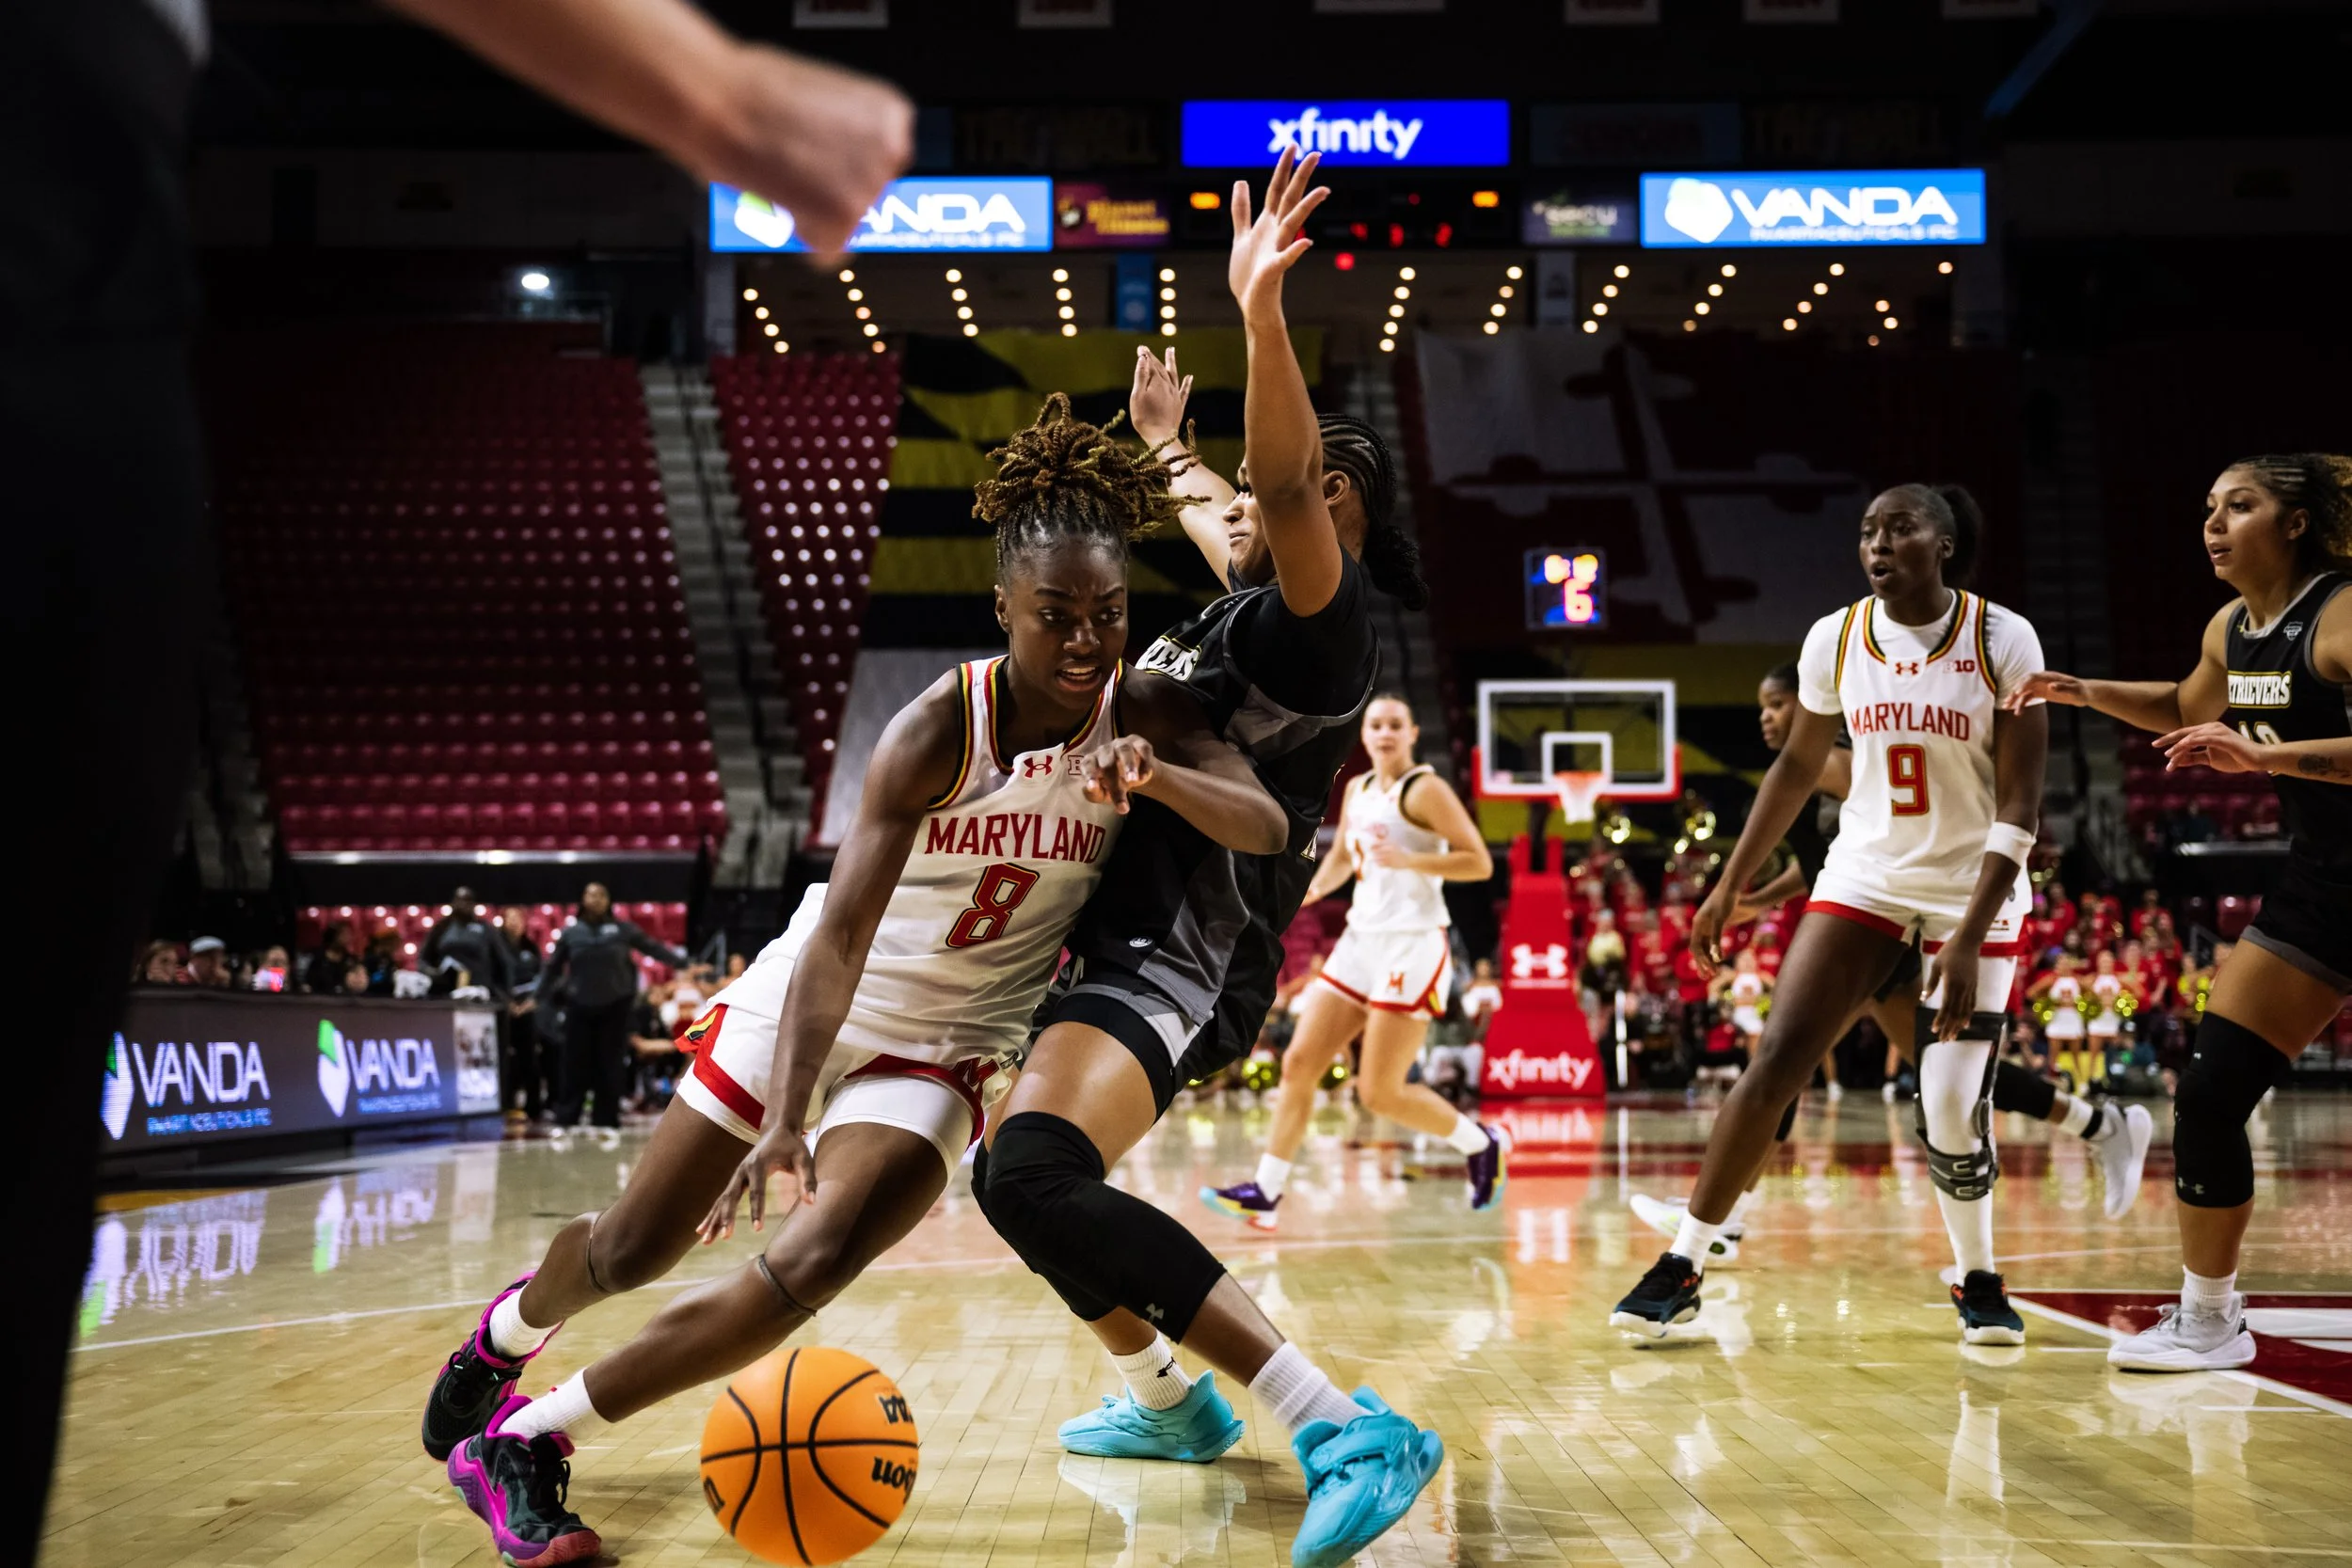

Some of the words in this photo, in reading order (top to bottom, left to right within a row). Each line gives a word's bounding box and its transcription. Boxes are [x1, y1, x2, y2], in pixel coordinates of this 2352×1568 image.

[1267, 106, 1422, 160] xfinity
[1730, 186, 1959, 227] VANDA
[1851, 702, 1970, 741] MARYLAND
[1886, 743, 1930, 816] 9
[924, 813, 1106, 864] MARYLAND
[946, 862, 1040, 949] 8
[133, 1041, 272, 1107] VANDA
[345, 1037, 441, 1093] VANDA
[1487, 1049, 1595, 1090] xfinity
